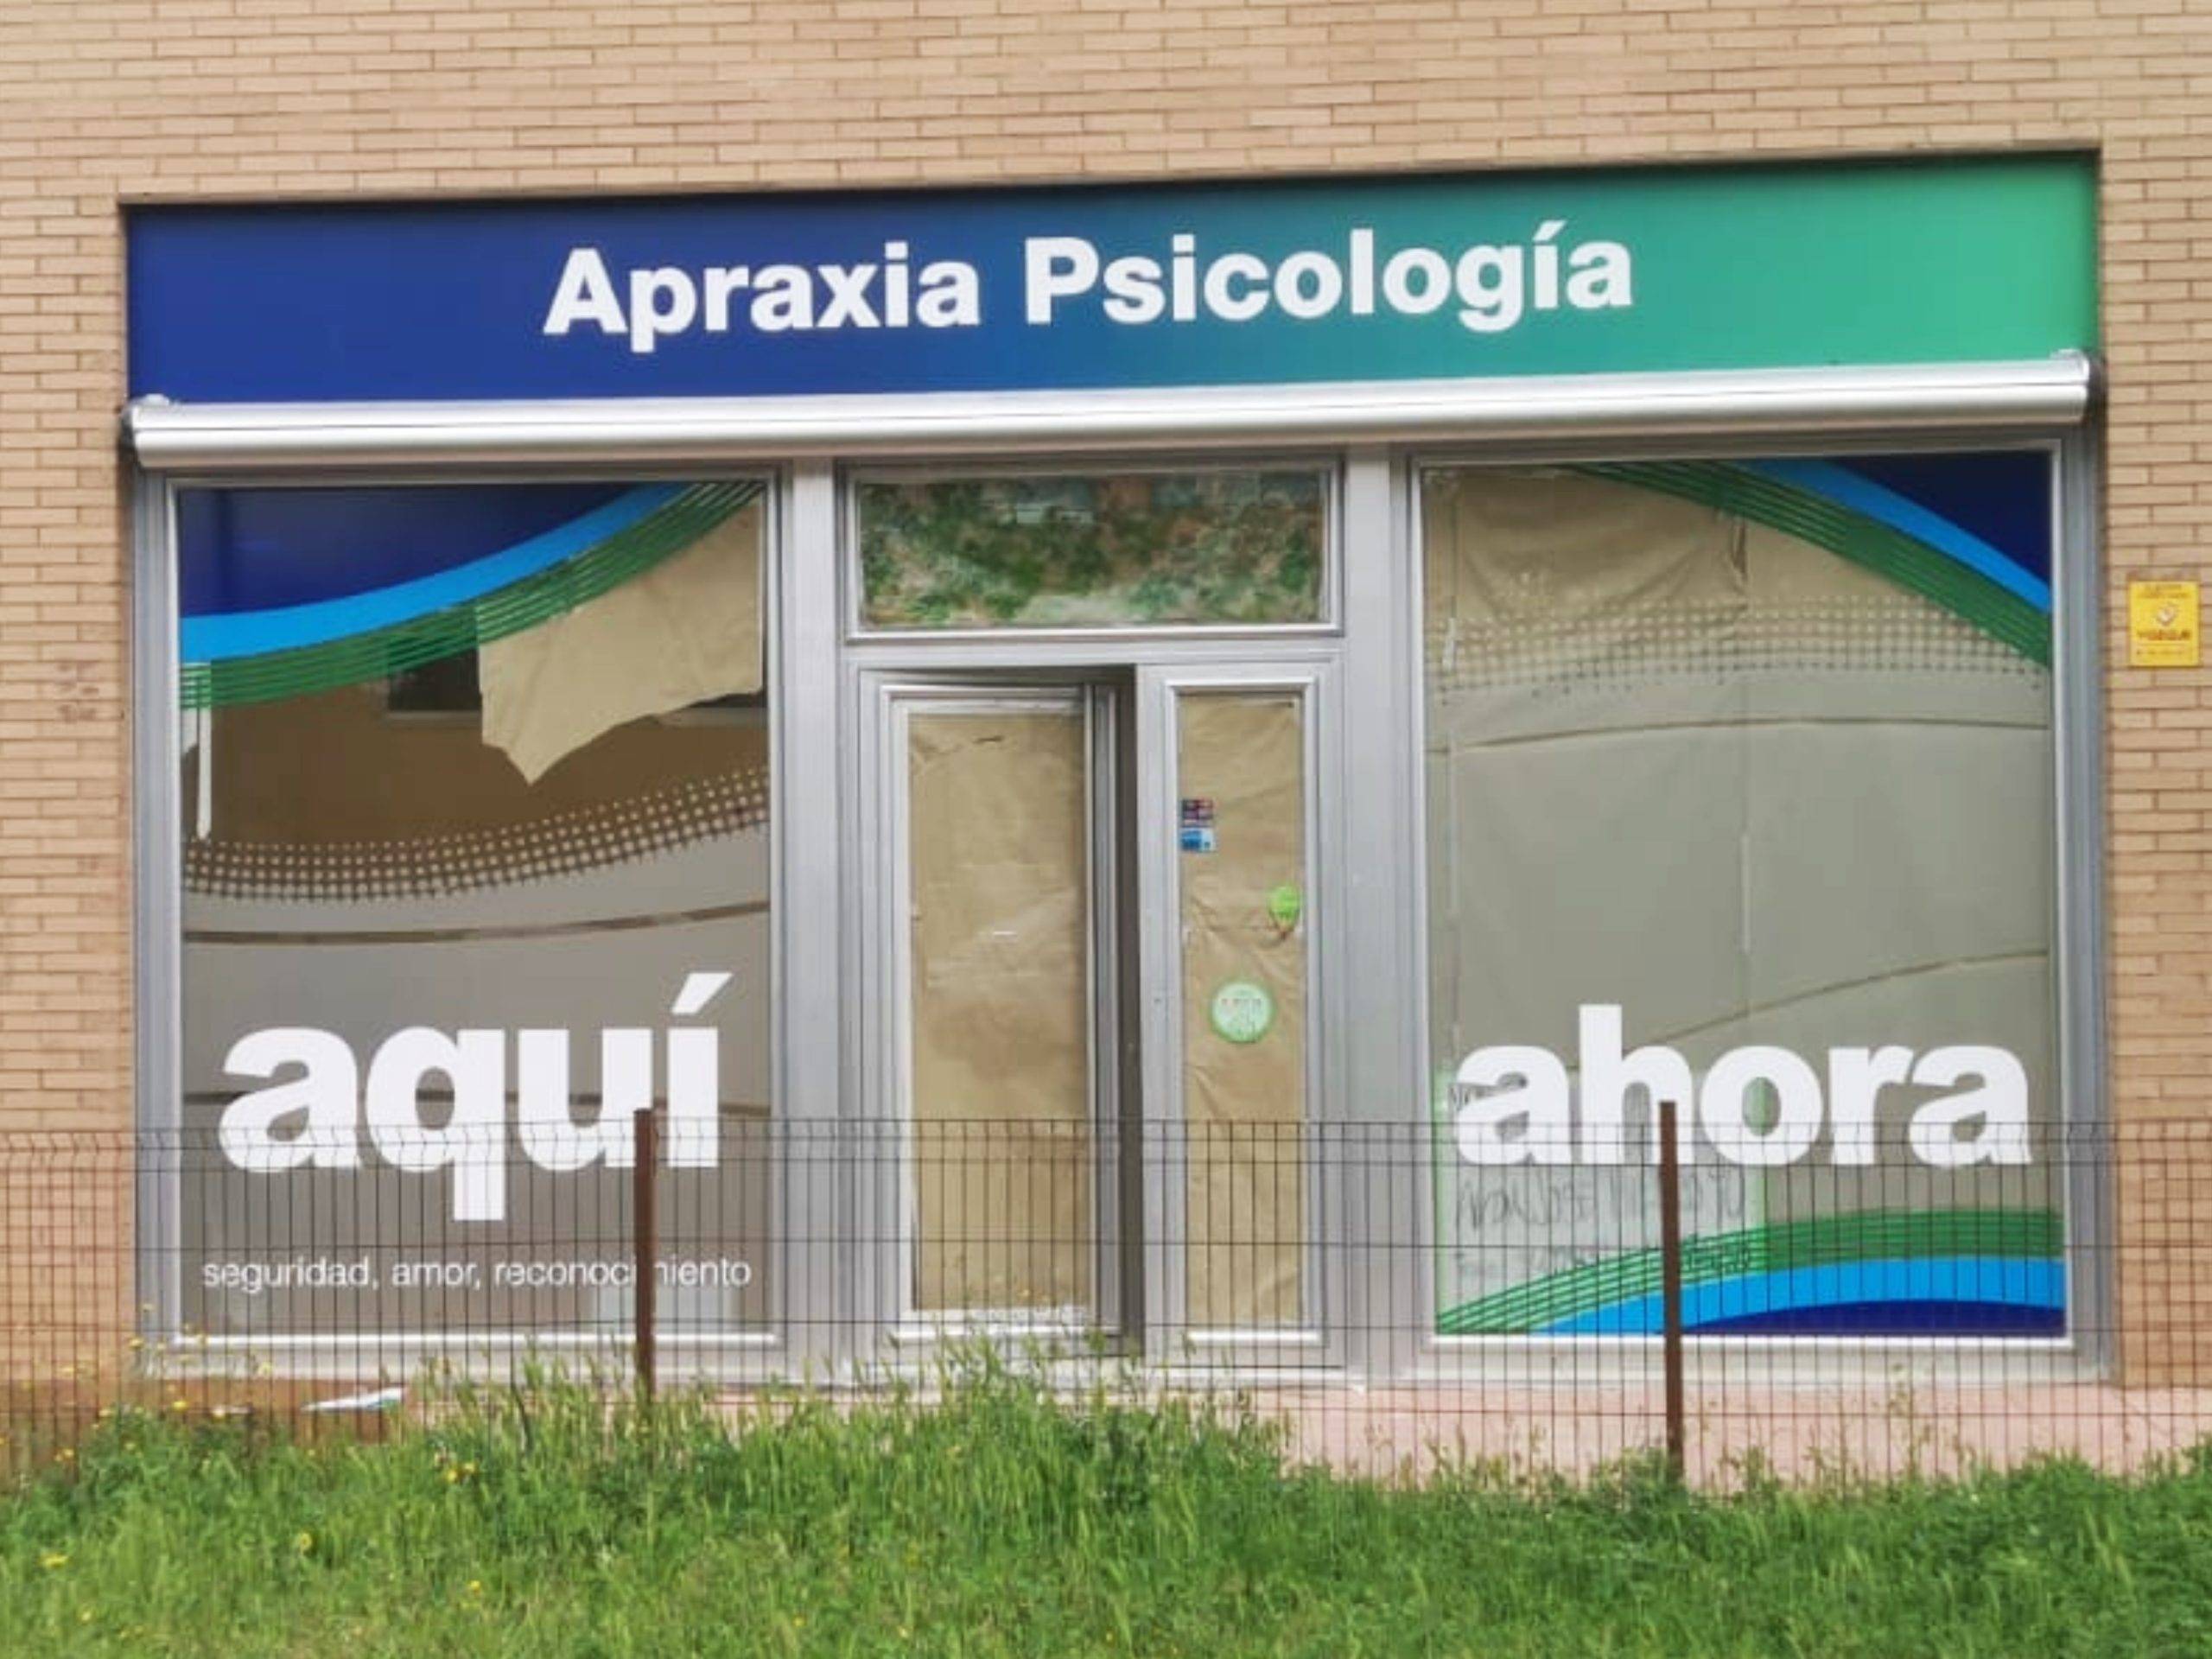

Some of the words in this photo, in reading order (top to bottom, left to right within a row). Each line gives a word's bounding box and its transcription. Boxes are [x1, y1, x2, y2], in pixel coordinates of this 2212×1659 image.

[543, 241, 980, 353] Apraxia
[1025, 219, 1632, 331] Psicología
[218, 972, 734, 1221] aquí
[1455, 1004, 2031, 1166] ahora
[203, 1255, 378, 1294] seguridad,
[392, 1262, 480, 1290] amor,
